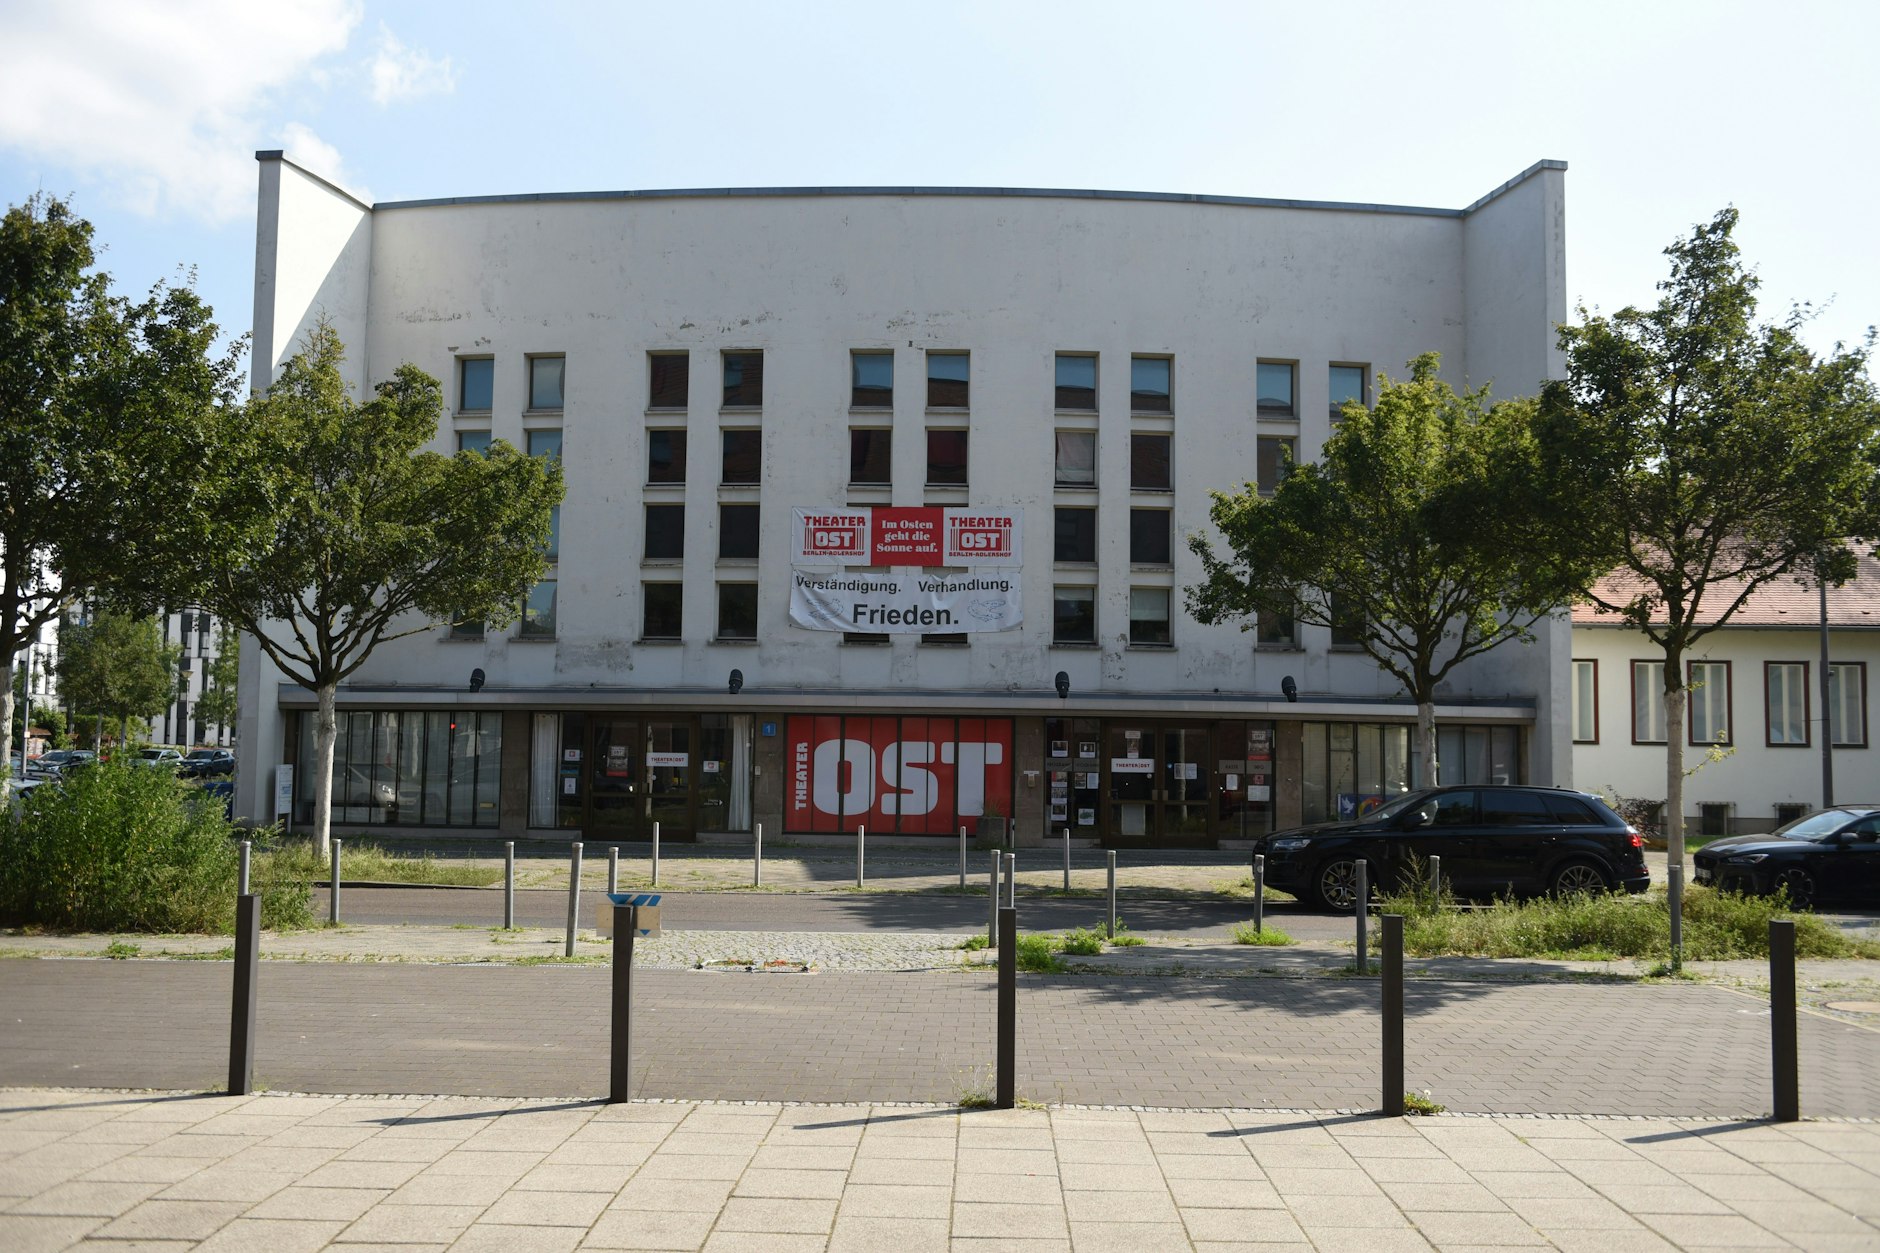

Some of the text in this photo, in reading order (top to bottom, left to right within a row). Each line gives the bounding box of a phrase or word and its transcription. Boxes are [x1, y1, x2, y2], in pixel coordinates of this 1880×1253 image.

[804, 516, 866, 526] THEATER
[881, 519, 933, 529] Im Osten
[949, 517, 1013, 527] THEATER
[815, 531, 854, 547] OST
[884, 531, 930, 543] geht die
[961, 532, 1000, 548] OST
[876, 543, 938, 553] Sonne auf.
[795, 575, 1014, 594] Verständigung. Verhandlung.
[852, 603, 959, 625] Frieden.
[795, 742, 808, 811] THEATER
[813, 738, 1003, 817] OST
